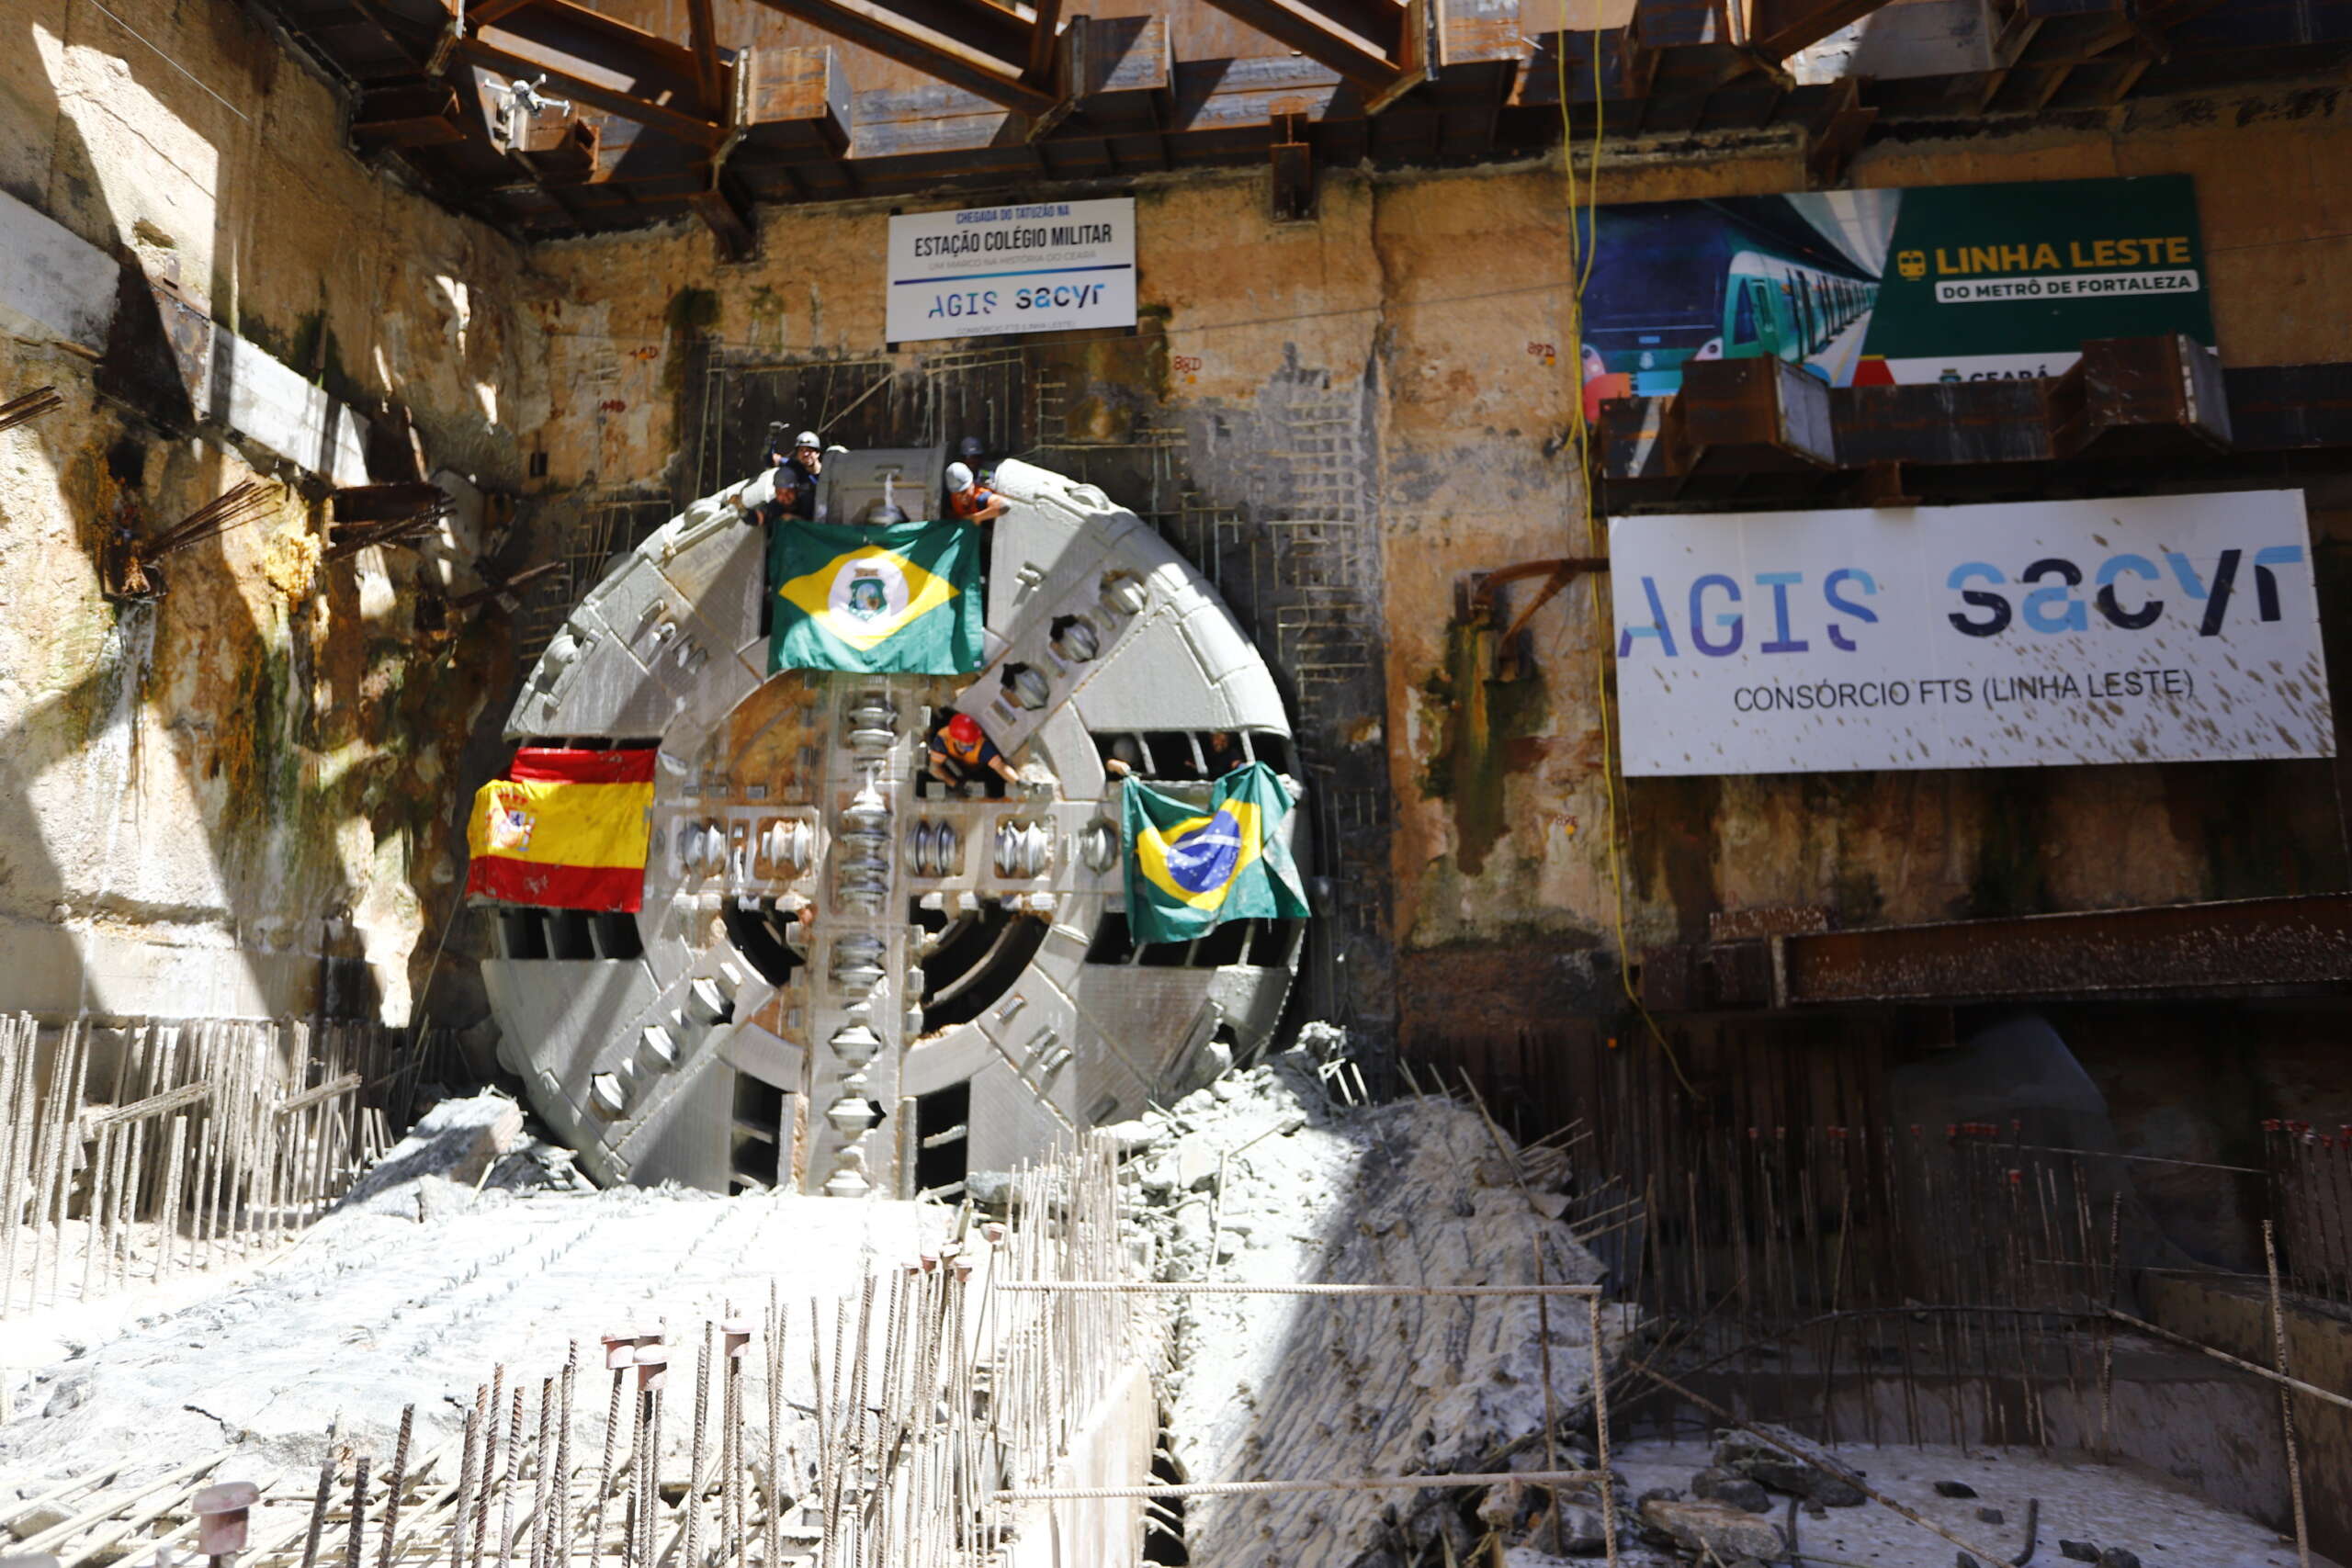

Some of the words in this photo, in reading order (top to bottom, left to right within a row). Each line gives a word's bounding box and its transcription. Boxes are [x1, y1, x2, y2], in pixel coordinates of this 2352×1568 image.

[956, 210, 998, 224] CHEGADA
[1001, 209, 1012, 221] DO
[1015, 204, 1055, 220] TATUZÃO
[1057, 205, 1069, 217] NA
[914, 231, 979, 258] ESTAÇÃO
[984, 227, 1046, 251] COLÉGIO
[1051, 224, 1113, 246] MILITAR
[1936, 243, 2061, 275] LINHA
[2070, 237, 2191, 268] LESTE
[928, 290, 998, 319] AGIS
[1015, 283, 1105, 310] sacyr
[1942, 286, 1970, 299] DO
[1976, 278, 2041, 298] METRÔ
[2047, 282, 2072, 295] DE
[2077, 275, 2192, 292] FORTALEZA
[1617, 568, 1879, 658] AGIS
[1946, 545, 2303, 637] sacyr
[1734, 678, 1910, 712] CONSÓRCIO
[1920, 679, 1973, 705] FTS
[1983, 673, 2081, 706] (LINHA
[2086, 670, 2195, 701] LESTE)
